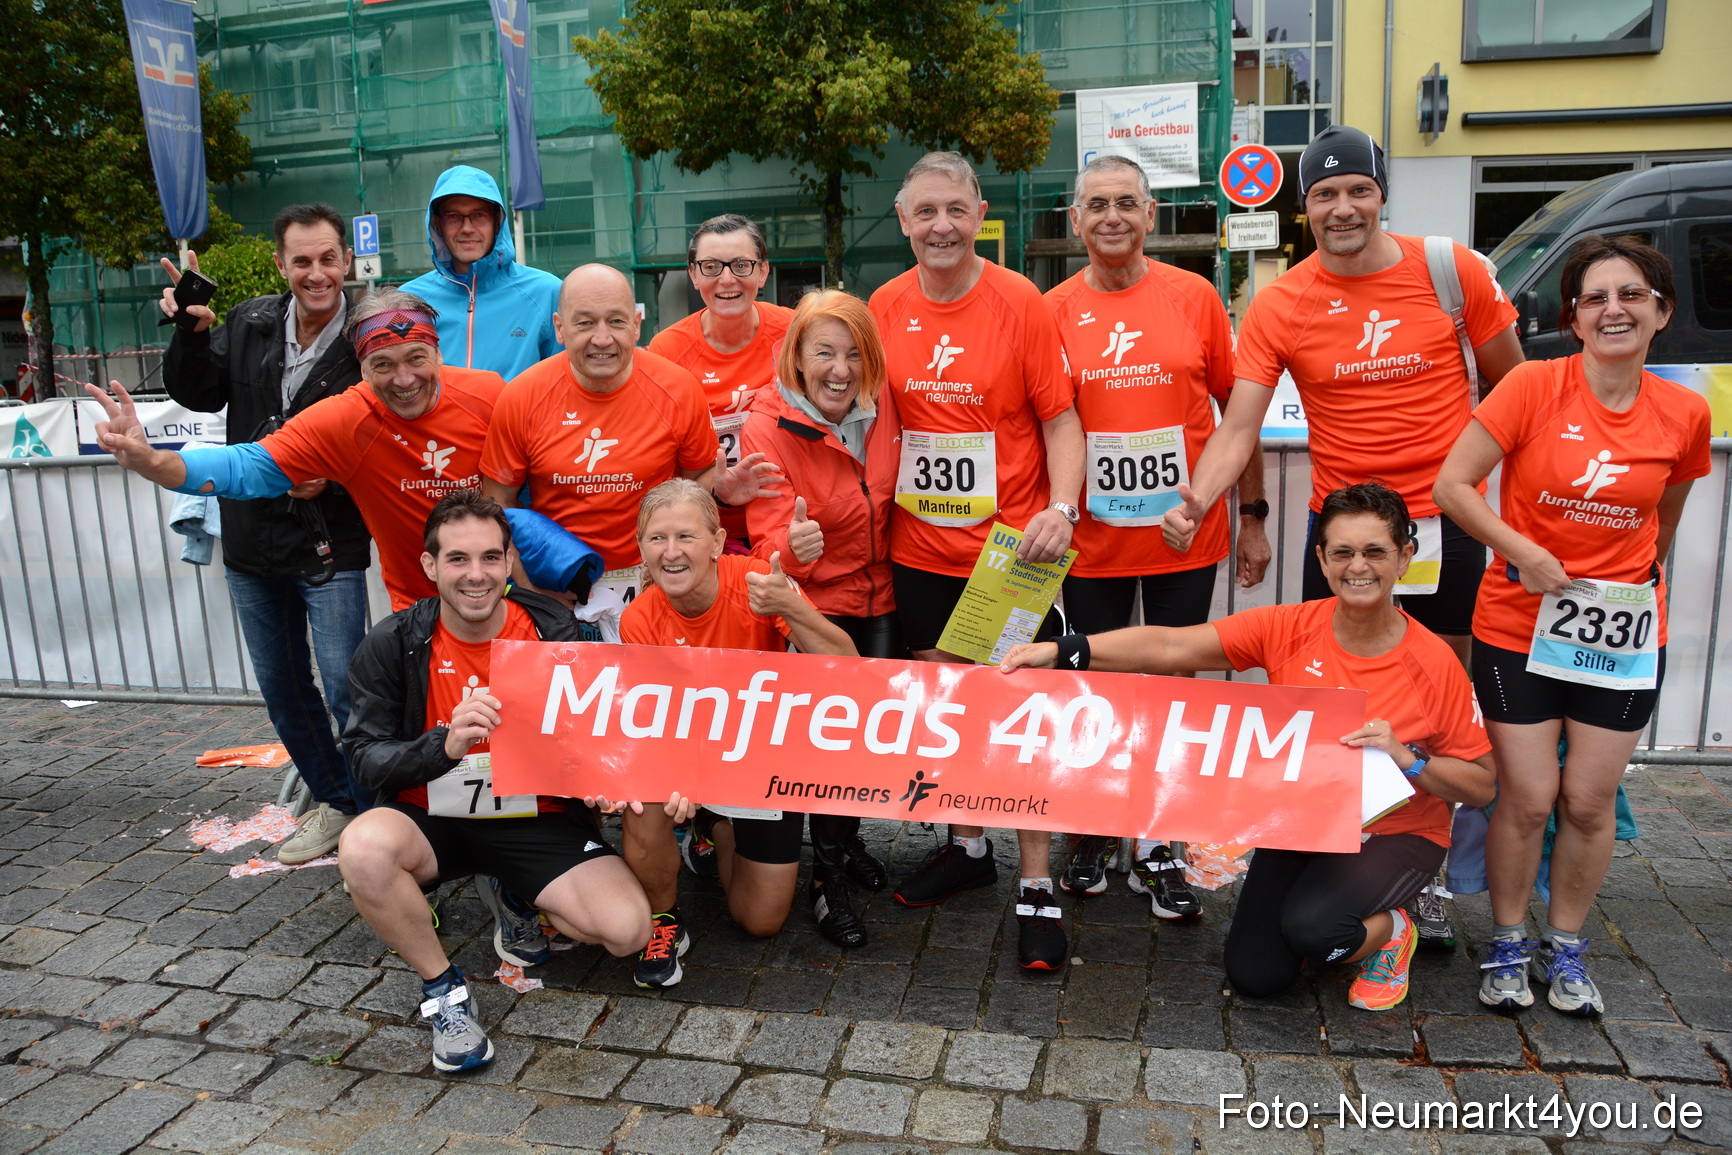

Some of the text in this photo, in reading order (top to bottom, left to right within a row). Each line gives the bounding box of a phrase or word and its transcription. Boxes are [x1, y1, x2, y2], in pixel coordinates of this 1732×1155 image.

[1108, 126, 1131, 139] Jura
[1134, 122, 1189, 137] Gerüstbau
[1230, 219, 1274, 230] Wendebereich
[359, 220, 372, 250] P
[1238, 232, 1267, 242] freihalten
[1328, 305, 1349, 315] erima
[1078, 317, 1096, 326] erima
[1081, 362, 1161, 385] funrunners
[1334, 352, 1421, 379] funrunners
[1362, 359, 1434, 383] neumarkt
[904, 377, 973, 393] funrunners
[1105, 372, 1174, 390] neumarkt
[925, 391, 985, 406] neumarkt
[936, 436, 986, 449] BOCK
[1129, 431, 1176, 448] BOCK
[1560, 432, 1584, 441] erima
[553, 472, 634, 485] funrunners
[914, 456, 975, 492] 330
[1097, 452, 1180, 491] 3085
[400, 474, 480, 492] funrunners
[576, 479, 645, 494] neumarkt
[918, 499, 971, 515] Manfred
[1108, 498, 1146, 512] Ernst
[1537, 490, 1639, 518] funrunners
[1563, 509, 1644, 530] neumarkt
[993, 531, 1070, 568] URDE
[986, 550, 1010, 573] 17.
[1013, 558, 1061, 580] Neumarkter
[1009, 567, 1049, 586] Stadtlauf
[1549, 598, 1653, 650] 2330
[1573, 650, 1617, 672] Stilla
[540, 664, 1315, 782] Manfreds 40. HM
[765, 775, 1049, 816] funrunners neumarkt
